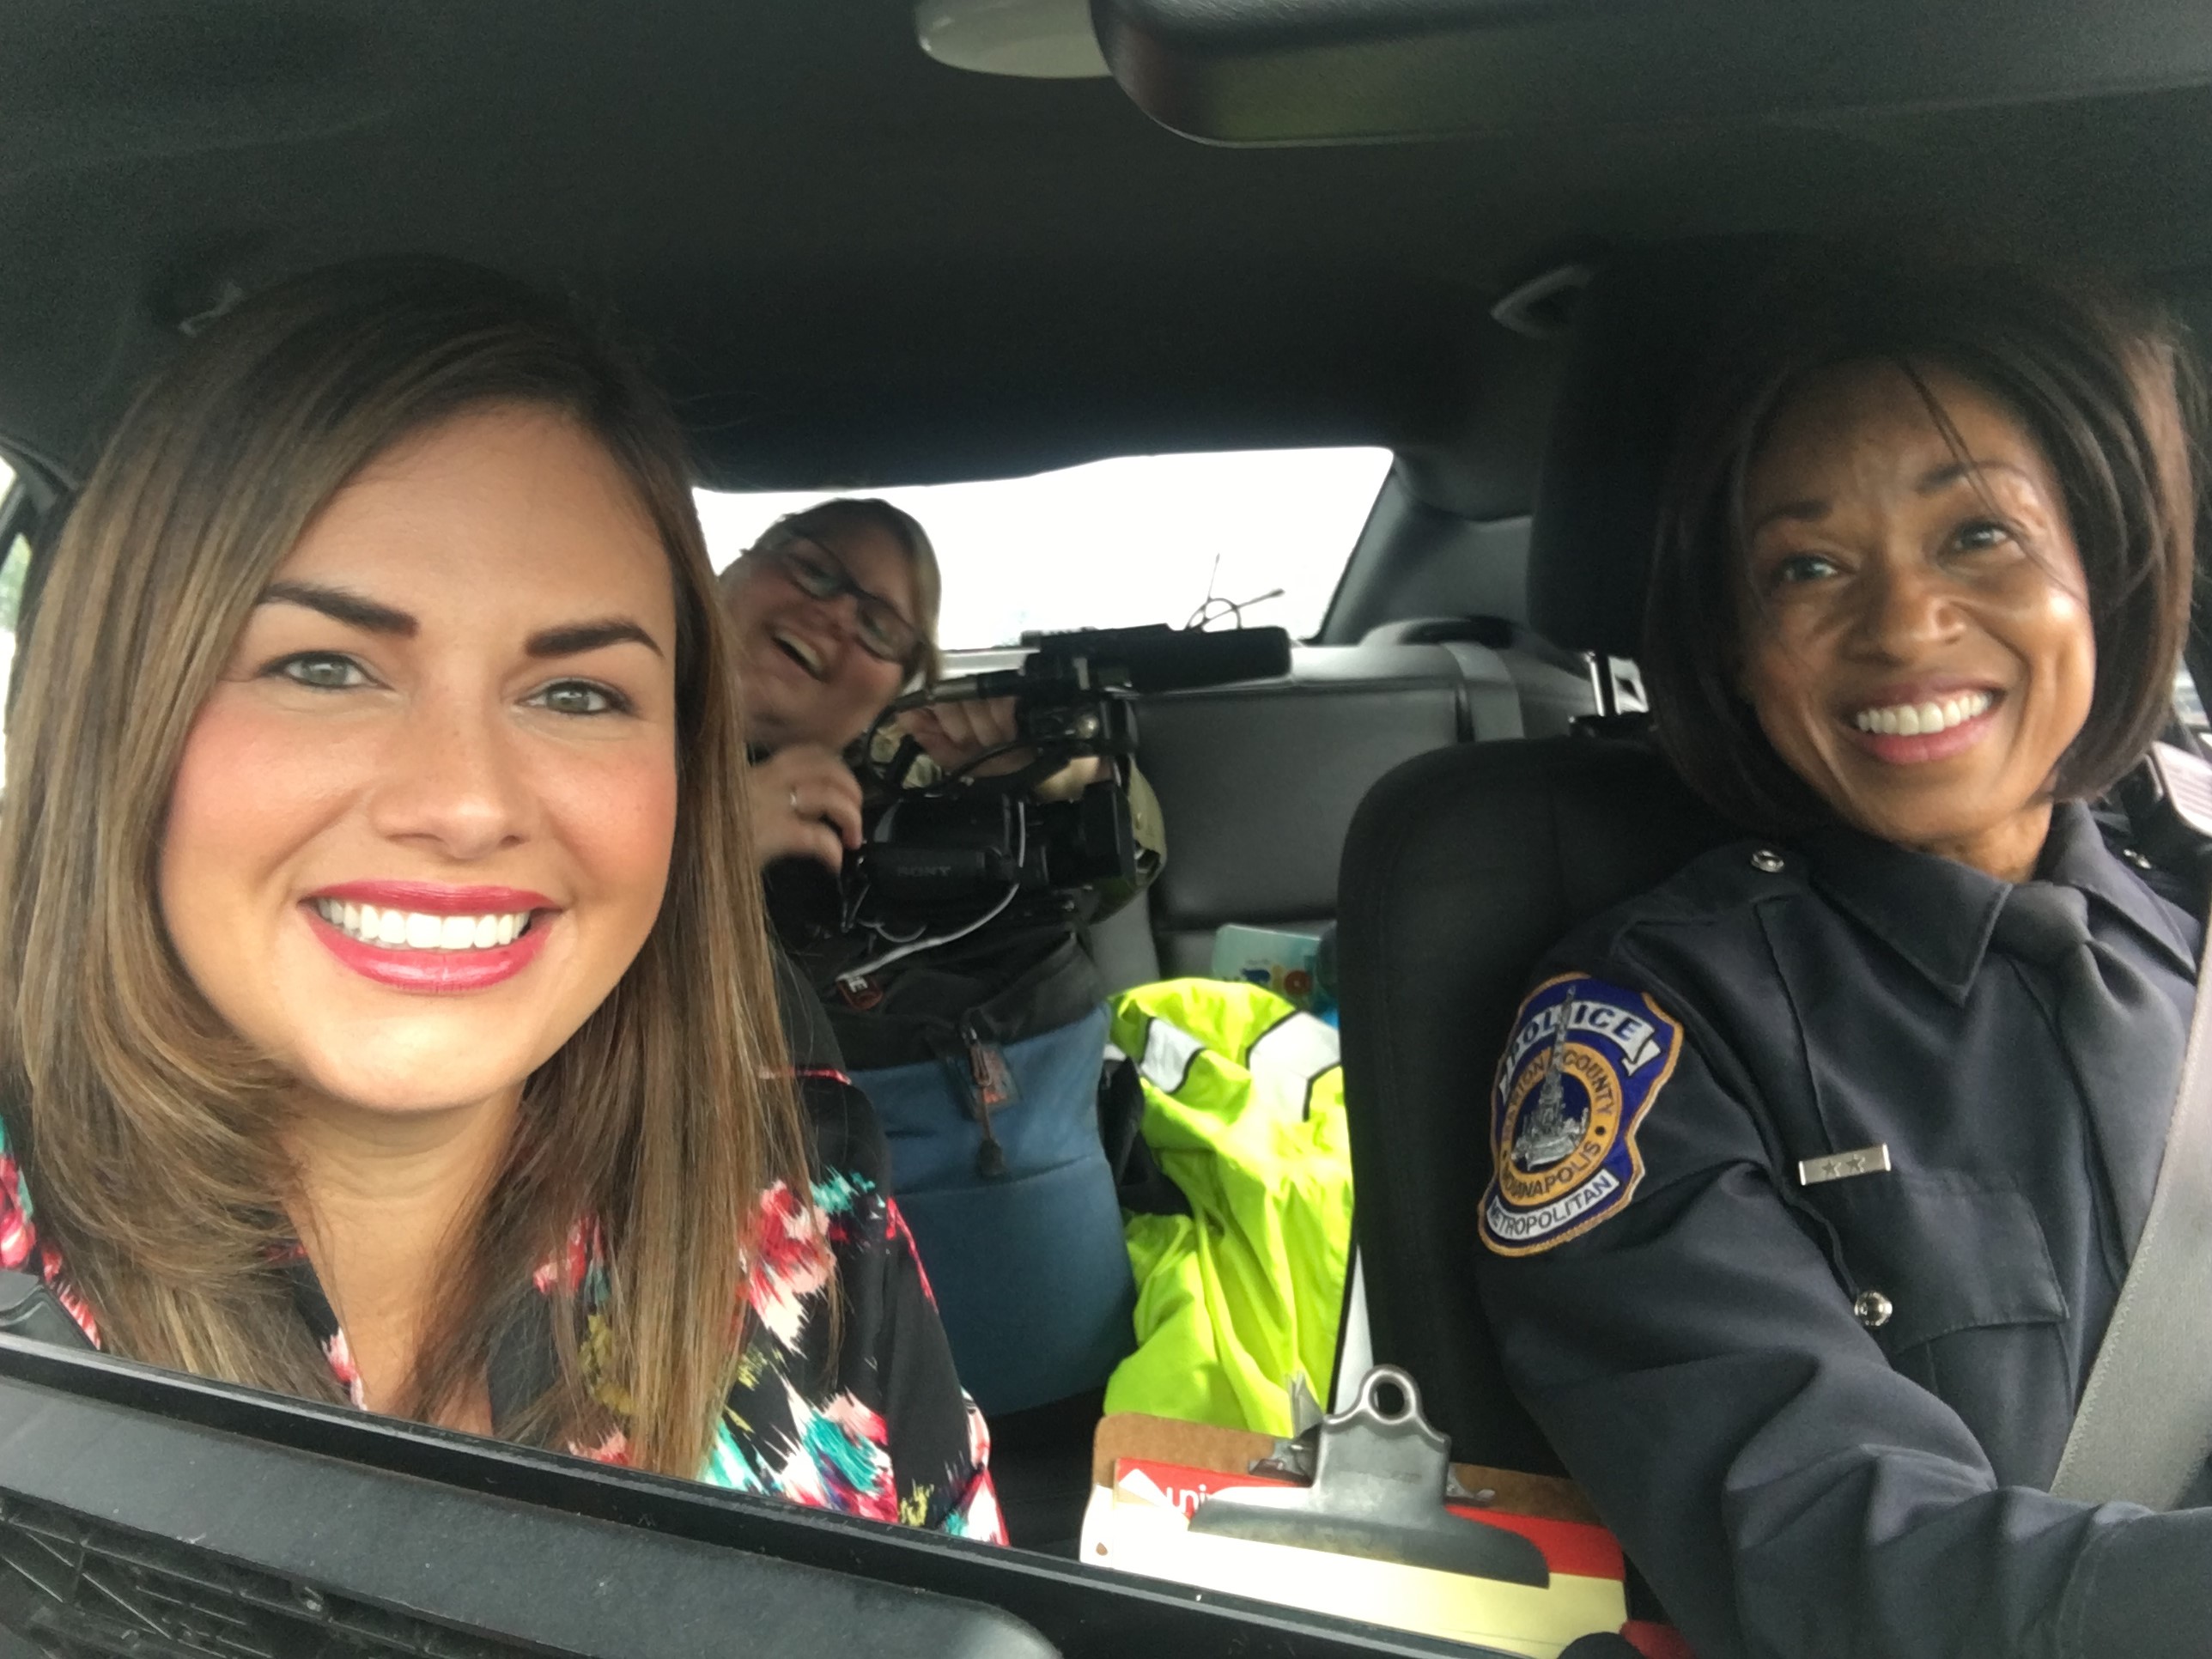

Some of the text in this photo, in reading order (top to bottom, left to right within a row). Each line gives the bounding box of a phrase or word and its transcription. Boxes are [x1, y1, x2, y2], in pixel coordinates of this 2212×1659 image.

[1510, 1003, 1643, 1067] POLICE
[1503, 1048, 1616, 1142] RION COUNTY
[1490, 1174, 1613, 1237] METROPOLITAN
